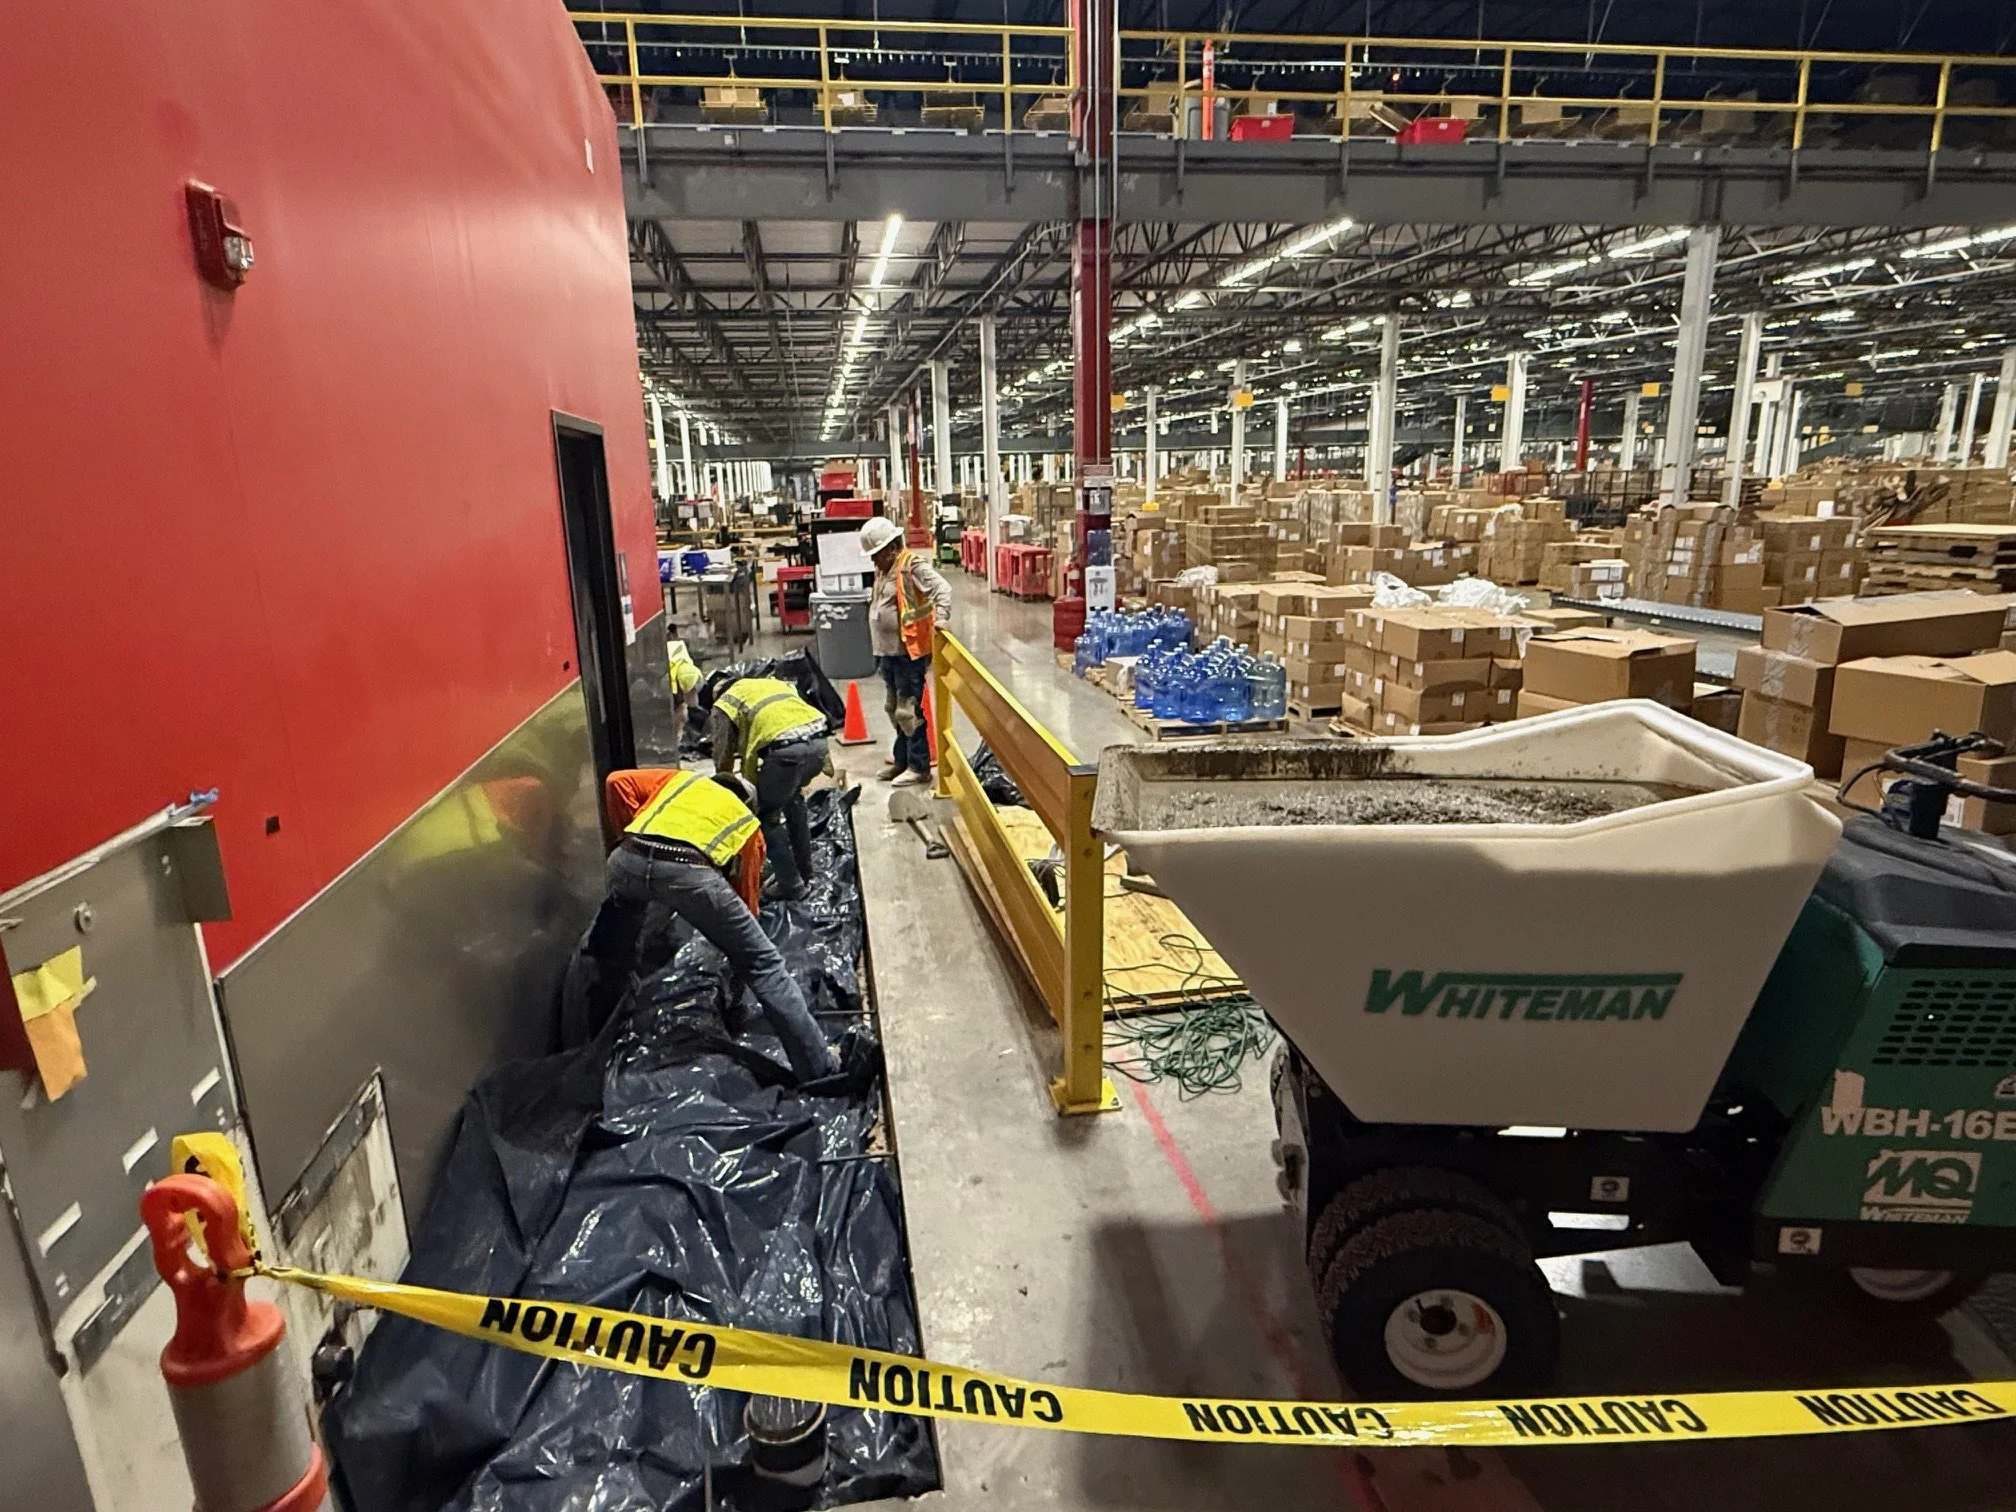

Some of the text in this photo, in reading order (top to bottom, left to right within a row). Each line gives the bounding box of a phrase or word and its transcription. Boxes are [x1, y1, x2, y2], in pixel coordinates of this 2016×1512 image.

[1363, 968, 1684, 1021] WHITEMAN
[1864, 1156, 1974, 1200] MQ
[479, 1298, 716, 1379] CAUTION
[849, 1357, 1064, 1423] CAUTION
[1795, 1390, 2007, 1426] CAUTION
[1182, 1403, 1394, 1439] CAUTION
[1496, 1399, 1708, 1437] CAUTION
